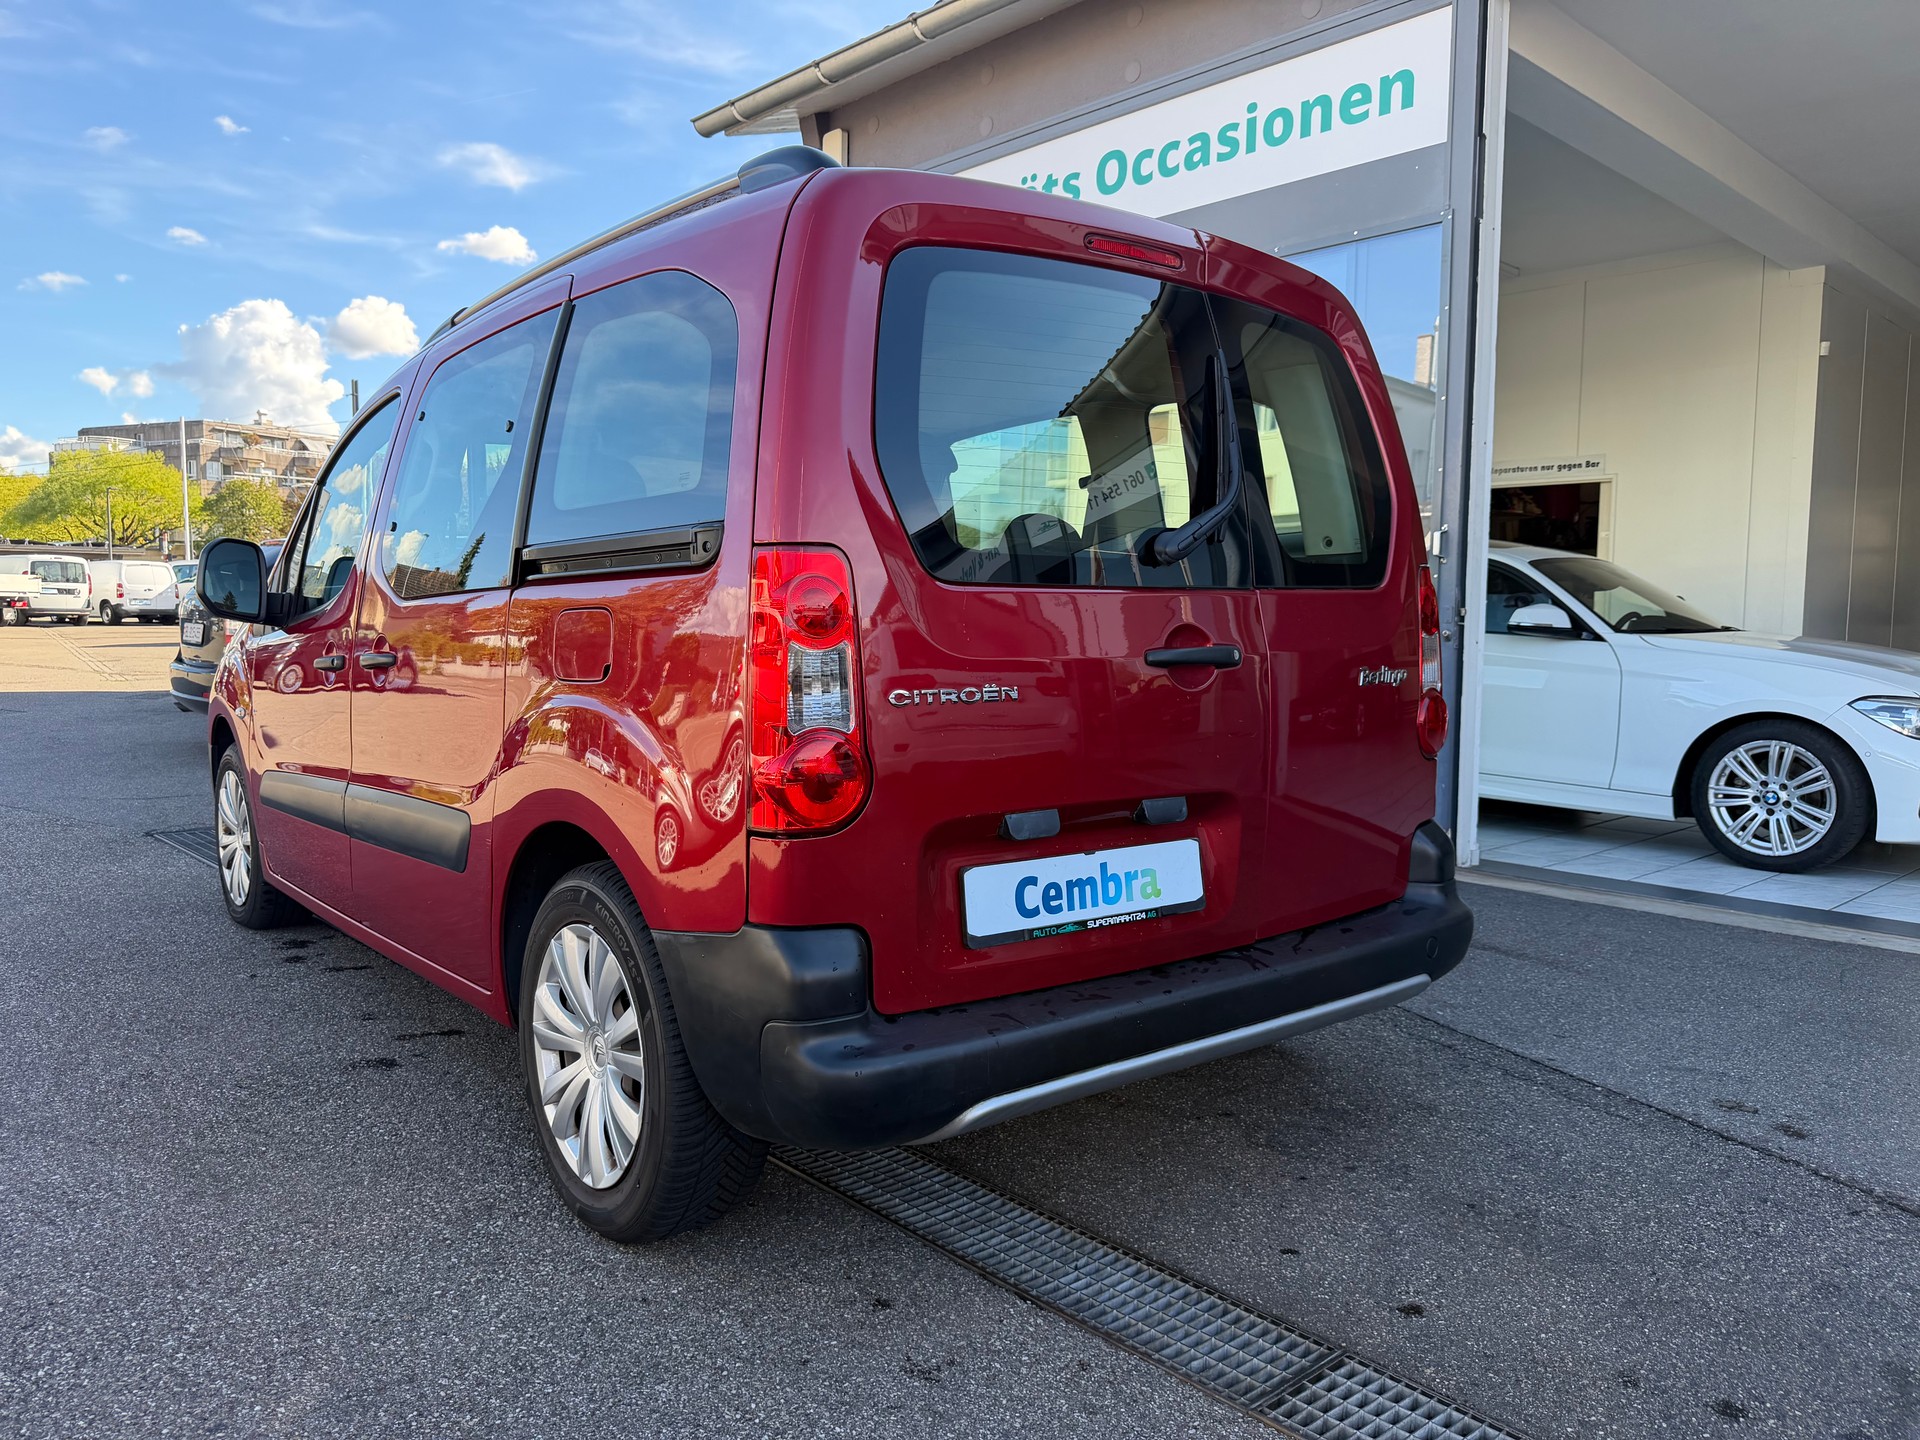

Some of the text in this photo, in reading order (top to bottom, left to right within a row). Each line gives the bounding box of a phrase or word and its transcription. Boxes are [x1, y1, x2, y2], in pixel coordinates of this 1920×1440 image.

[1096, 68, 1414, 196] Occasionen
[1557, 462, 1583, 472] gegen
[1585, 460, 1600, 468] Bar
[1358, 665, 1407, 686] Berlingo
[888, 683, 1019, 708] CITROËN
[1015, 861, 1162, 919] Cembra
[595, 902, 630, 952] KINERGY
[1033, 910, 1157, 938] AUTO SUPERMARKT24 AG
